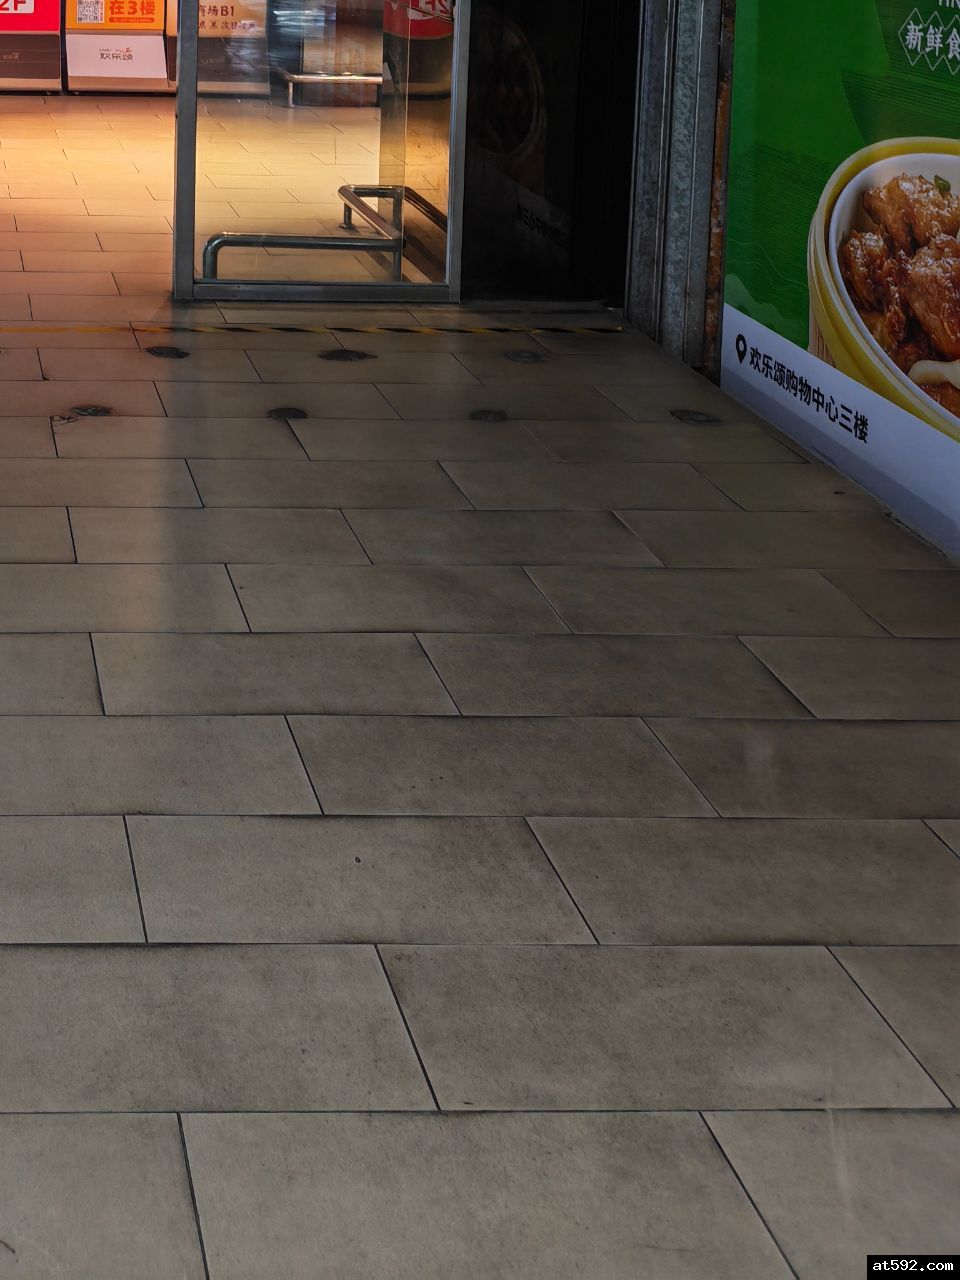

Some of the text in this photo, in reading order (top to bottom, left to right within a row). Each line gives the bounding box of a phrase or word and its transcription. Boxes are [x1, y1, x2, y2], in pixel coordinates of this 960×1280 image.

[109, 0, 155, 16] 在3楼
[749, 347, 869, 444] 欢乐颂购物中心三楼
